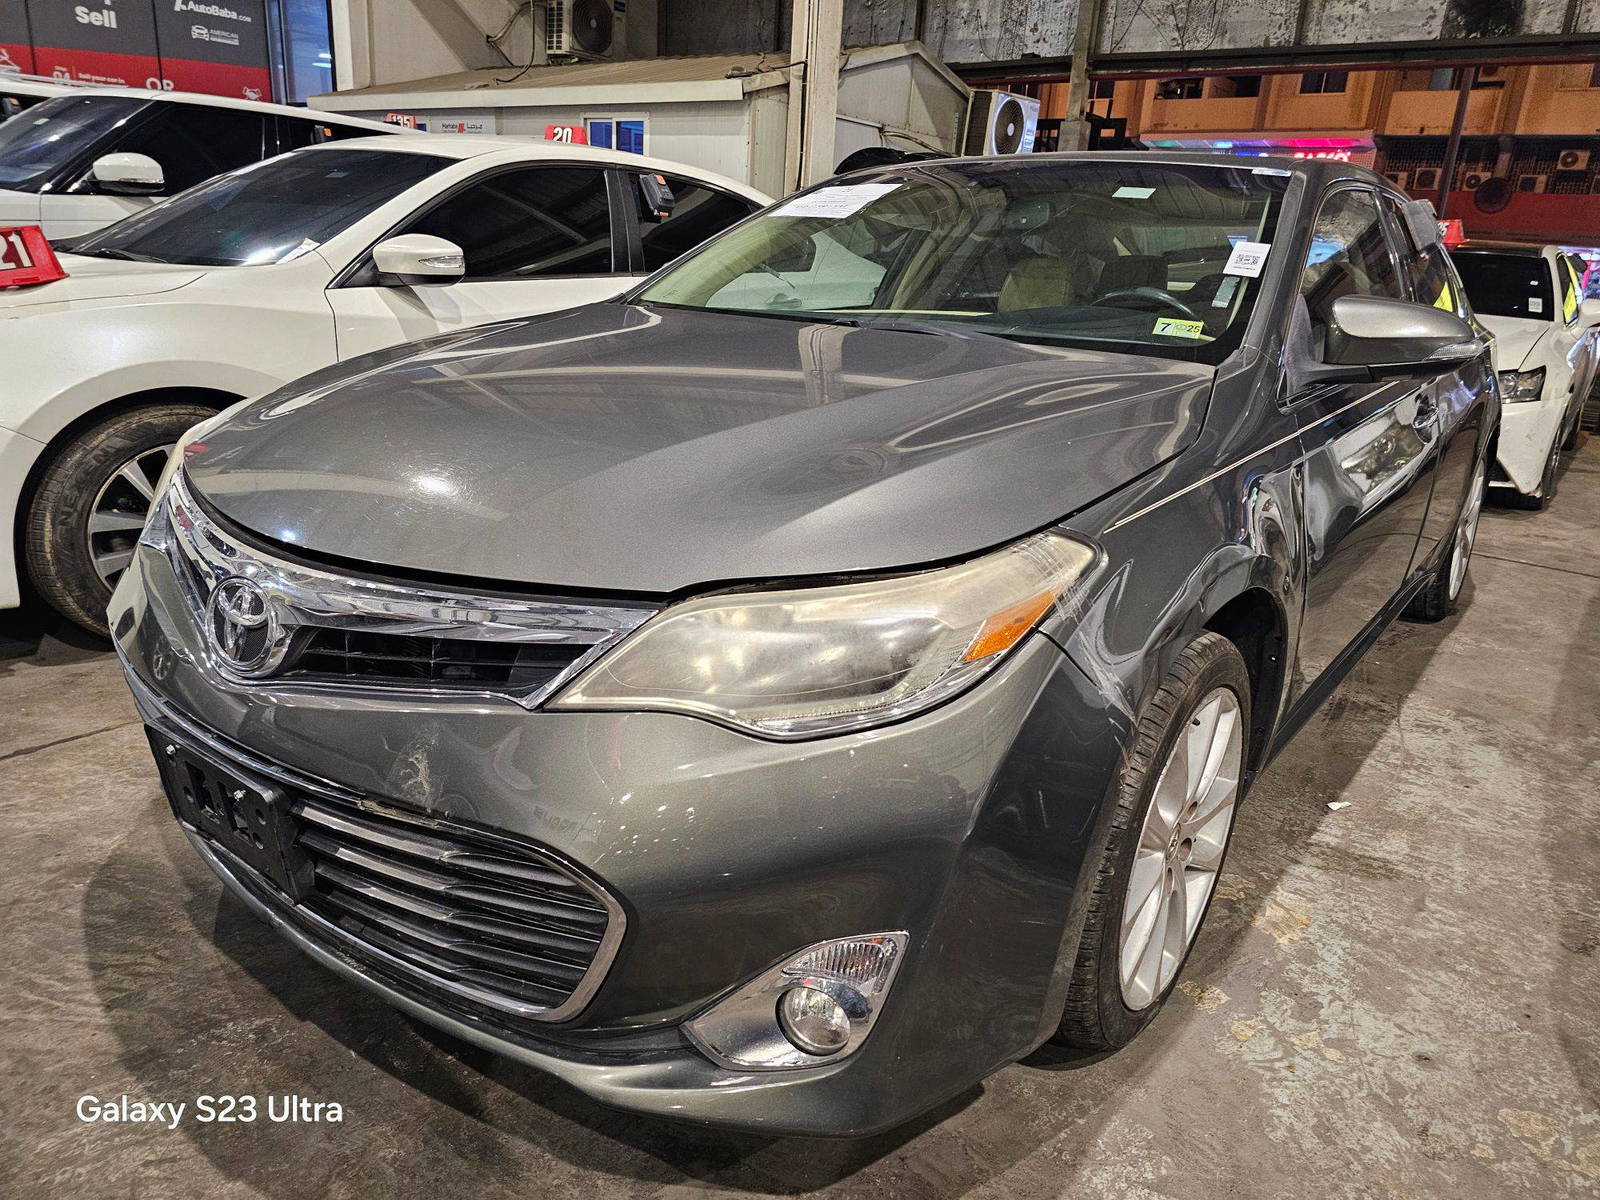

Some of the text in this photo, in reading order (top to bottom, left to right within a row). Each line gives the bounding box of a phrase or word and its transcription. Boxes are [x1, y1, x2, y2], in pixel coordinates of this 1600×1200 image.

[74, 5, 117, 28] Sell
[1161, 322, 1201, 333] 7 25
